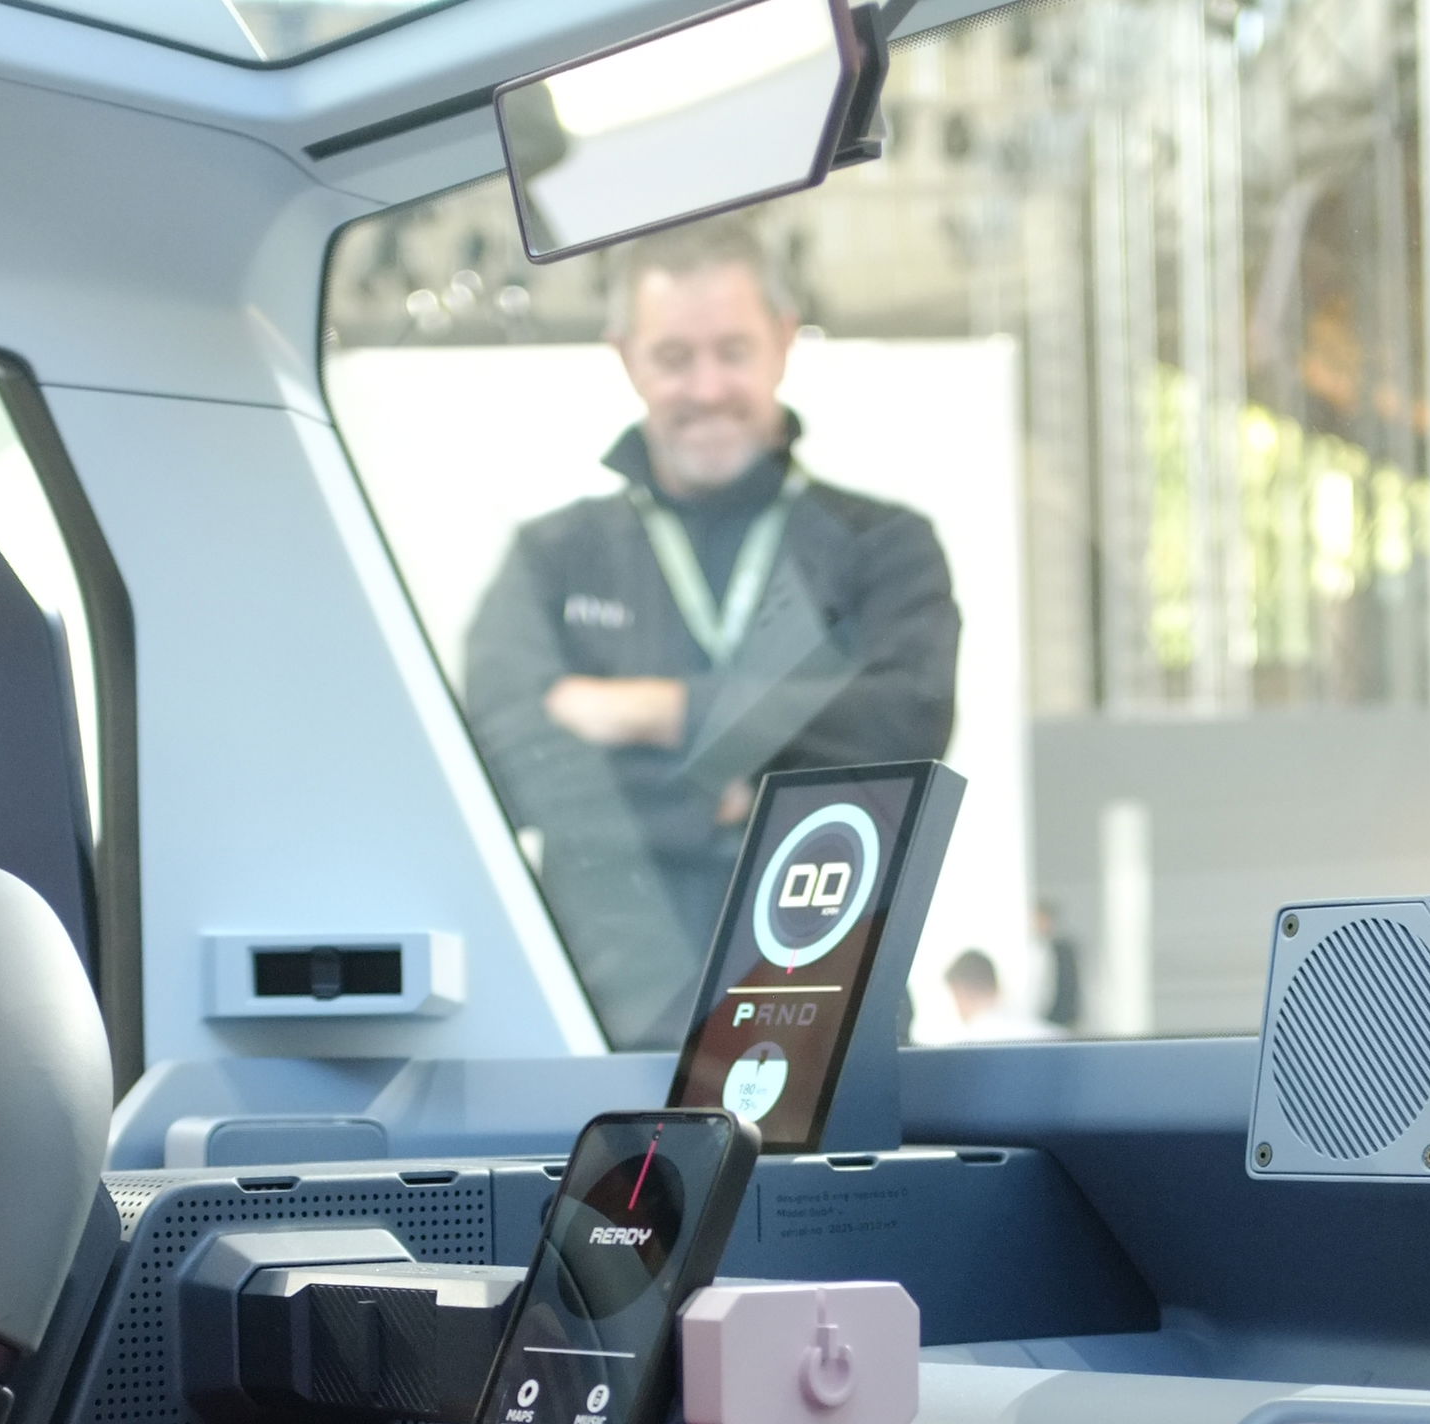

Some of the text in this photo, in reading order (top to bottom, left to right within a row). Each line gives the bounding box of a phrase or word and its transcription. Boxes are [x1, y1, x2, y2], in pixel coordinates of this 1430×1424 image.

[778, 862, 851, 907] 00
[589, 1227, 652, 1245] READY
[506, 1409, 534, 1423] MAPS
